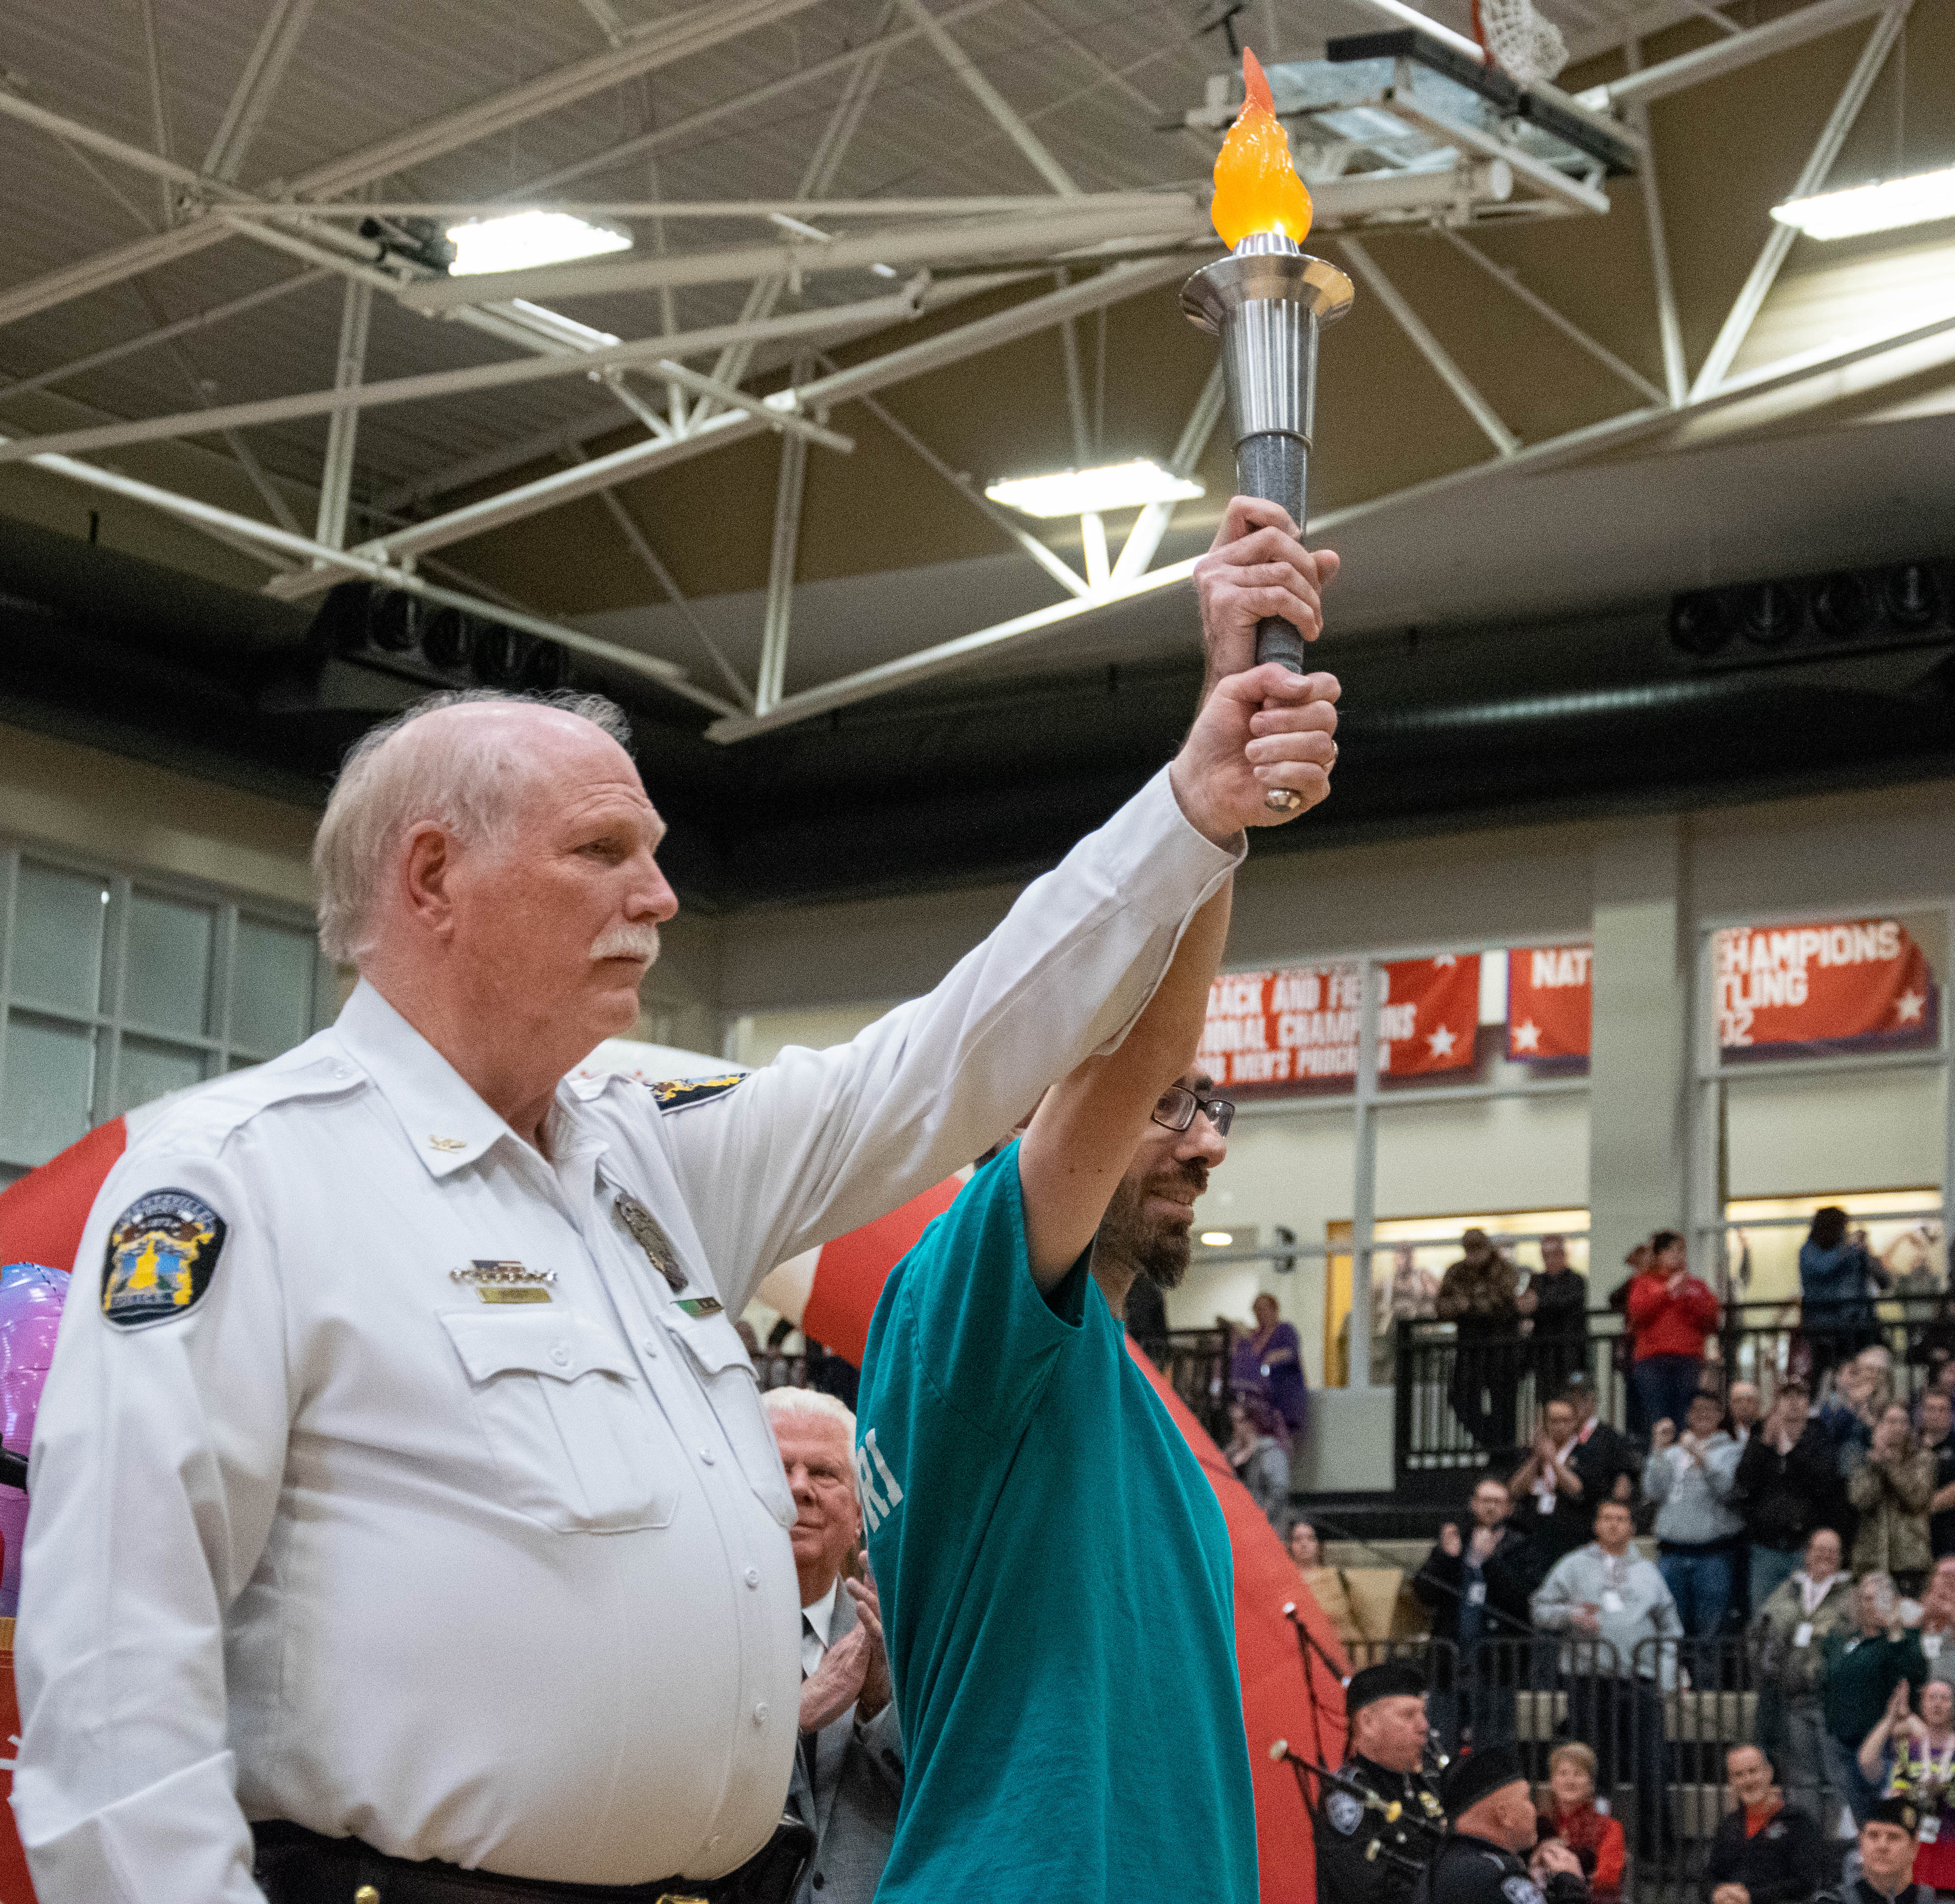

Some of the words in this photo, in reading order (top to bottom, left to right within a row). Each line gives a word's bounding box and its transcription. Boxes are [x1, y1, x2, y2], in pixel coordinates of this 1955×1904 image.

[1532, 949, 1593, 989] NAT
[1272, 976, 1320, 1013] AND
[1329, 969, 1390, 1009] FIED
[1297, 1042, 1391, 1077] PROGRM
